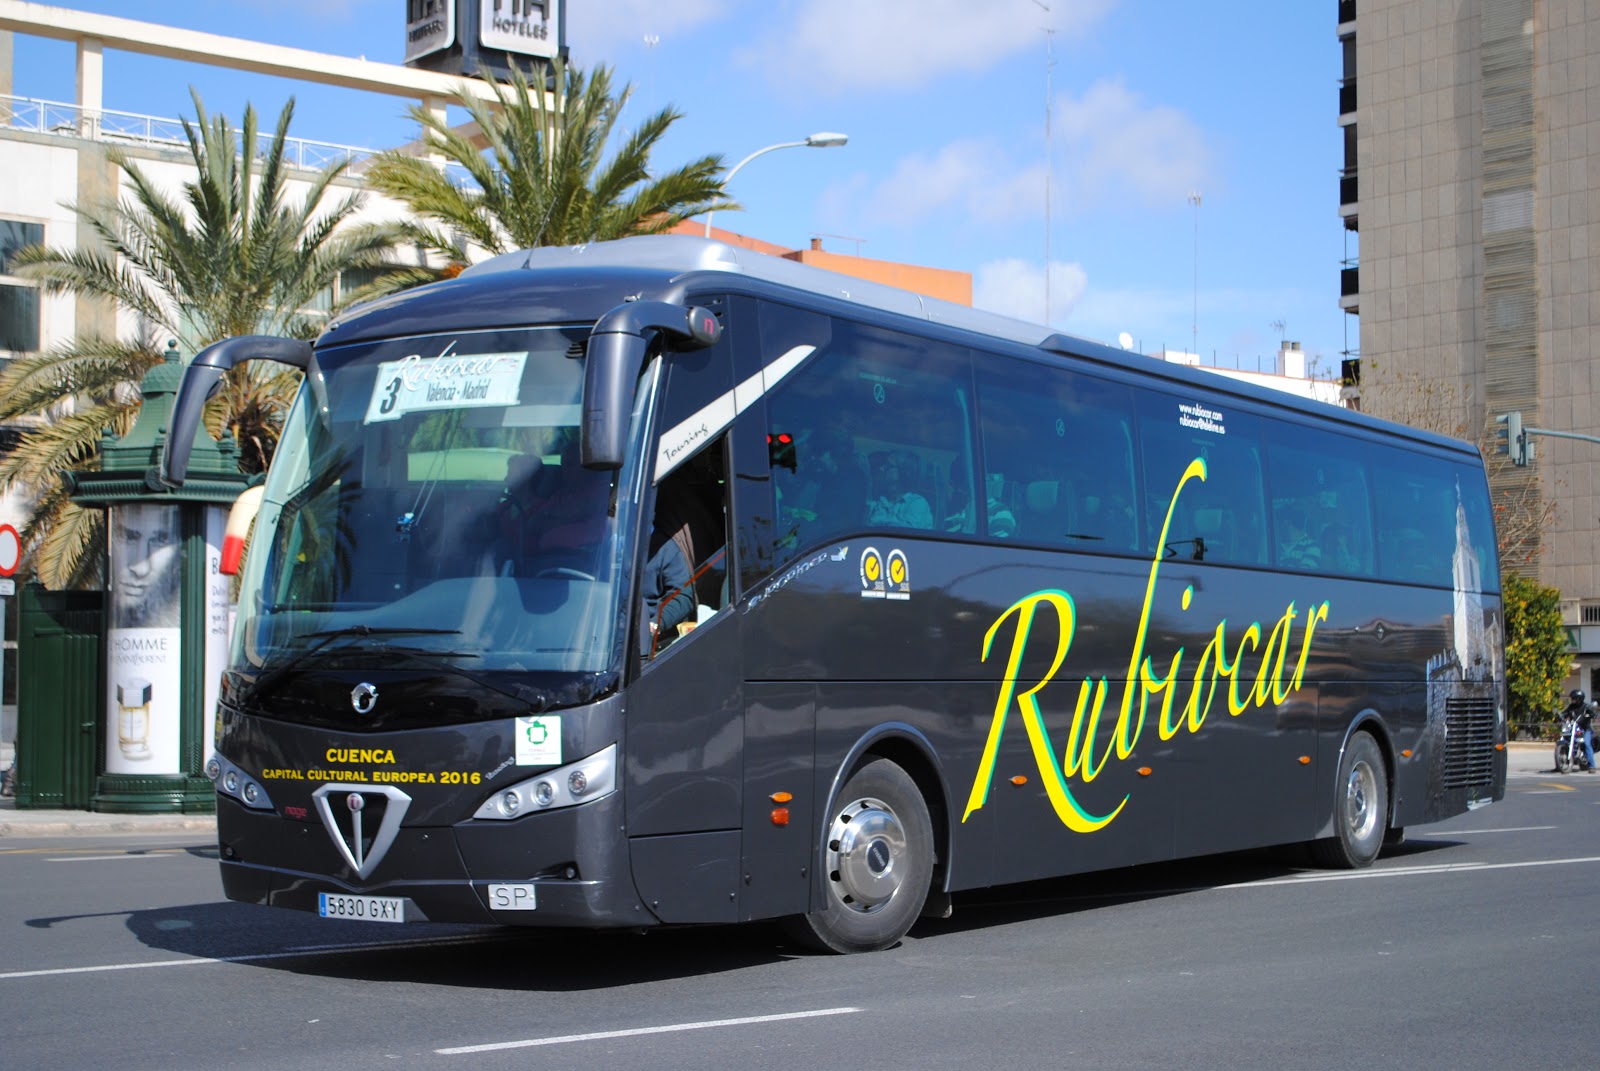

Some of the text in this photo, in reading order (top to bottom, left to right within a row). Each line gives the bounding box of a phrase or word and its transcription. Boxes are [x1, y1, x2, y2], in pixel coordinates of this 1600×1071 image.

[493, 17, 548, 40] HOTELES
[380, 377, 402, 414] 3
[462, 379, 491, 400] Madrid
[663, 423, 708, 461] Touring
[962, 457, 1330, 833] Rubiocar
[325, 748, 396, 764] CUENCA
[262, 768, 482, 785] CAPITAL CULTURAL EUROPEA 2016
[328, 896, 399, 919] 5830 GXY
[497, 887, 528, 907] SP
